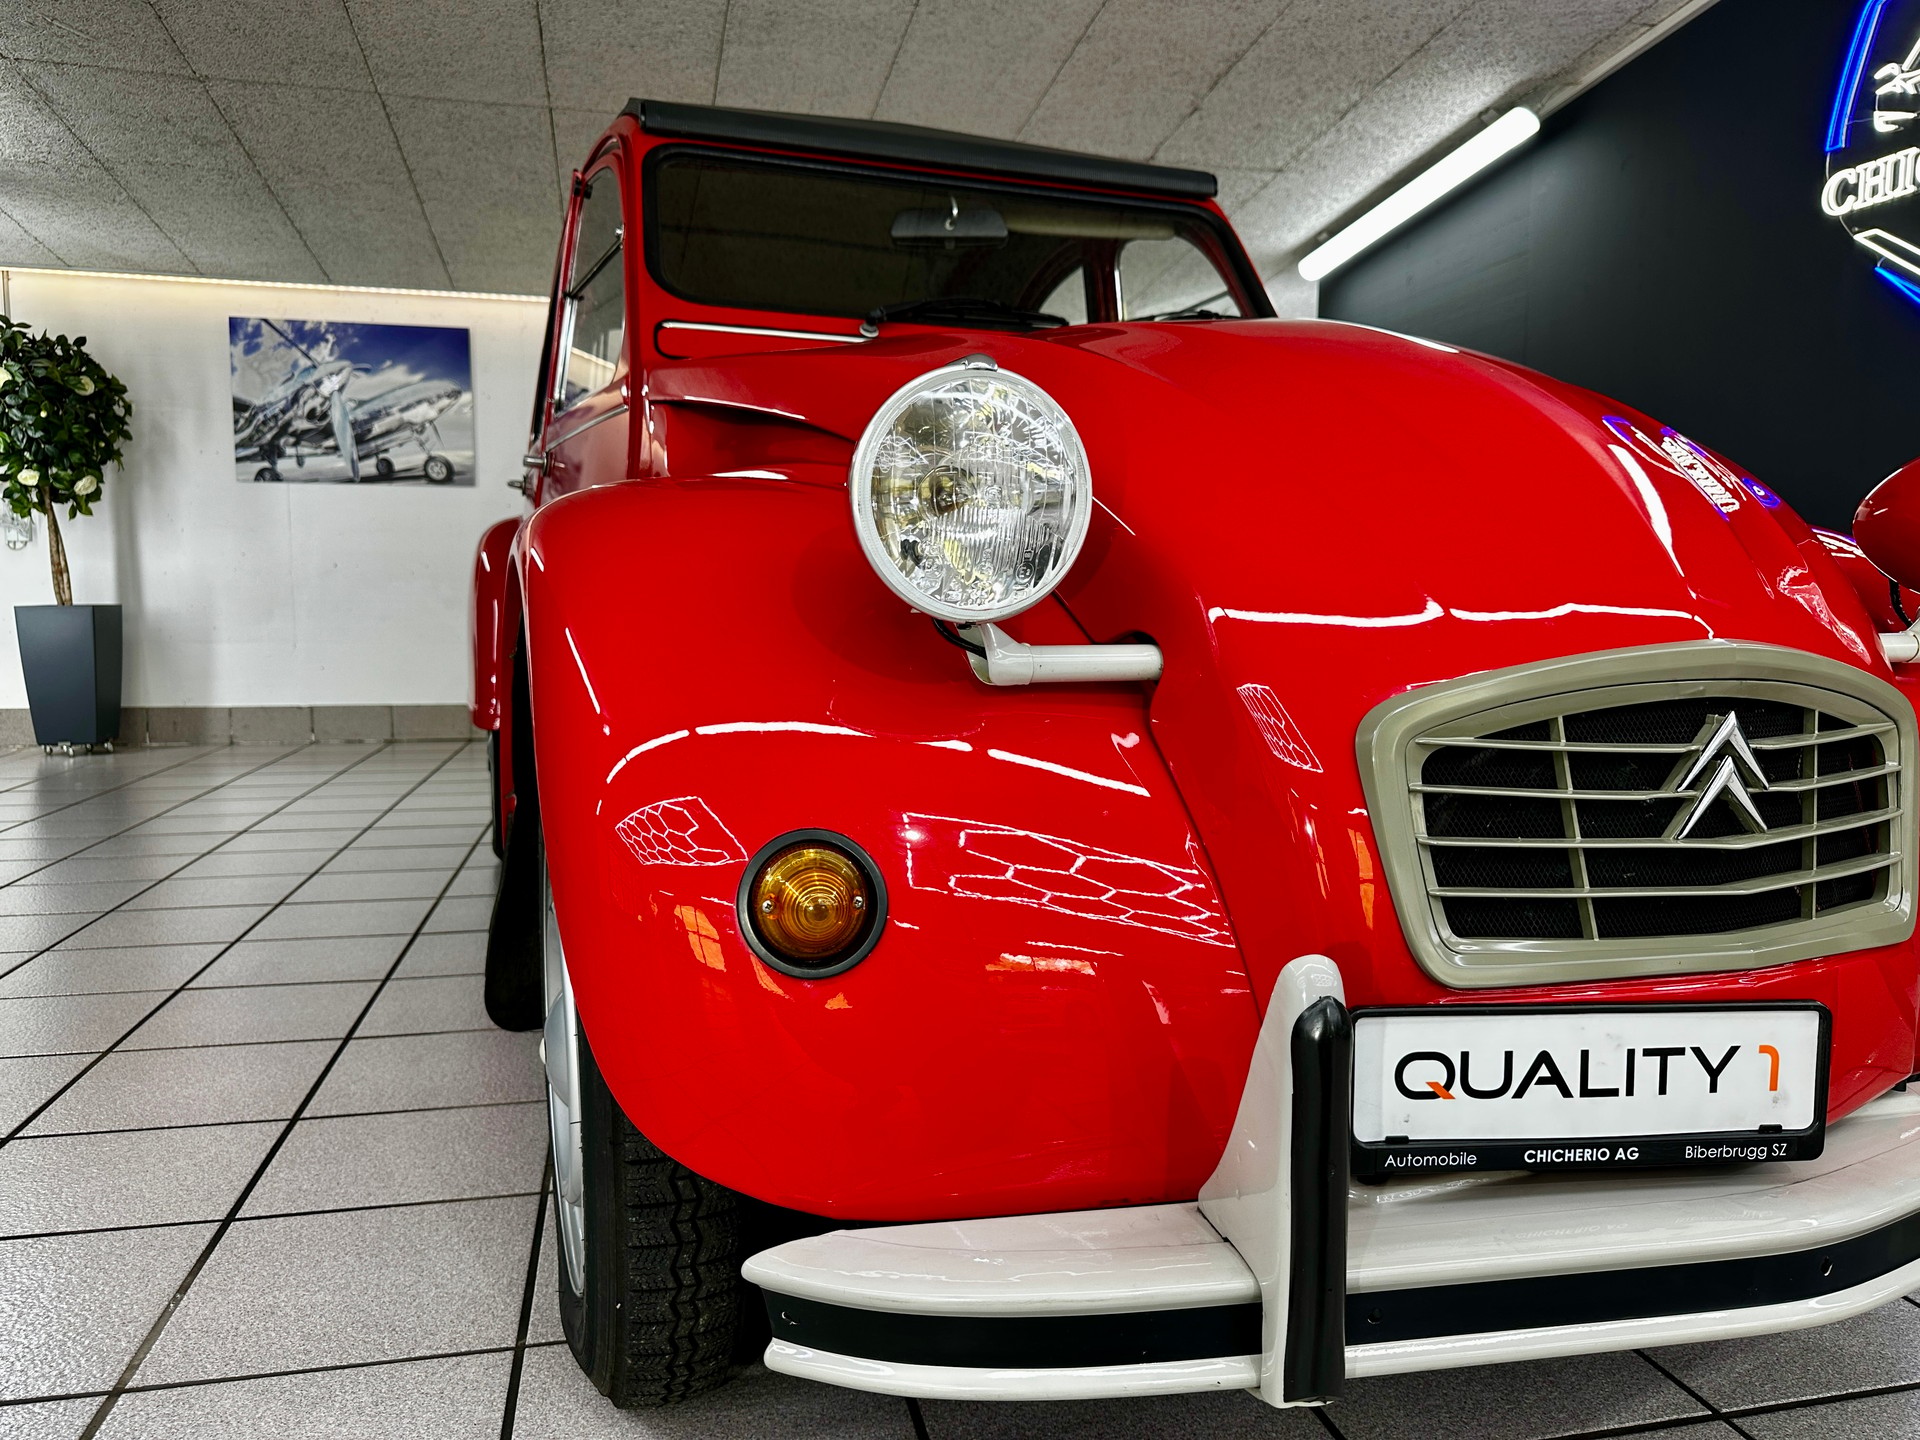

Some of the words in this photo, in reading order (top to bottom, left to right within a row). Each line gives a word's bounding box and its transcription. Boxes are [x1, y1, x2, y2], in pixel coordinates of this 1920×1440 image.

[1821, 147, 1920, 216] CHI
[1394, 1045, 1742, 1100] QUALITY
[1758, 1044, 1780, 1092] 1
[1384, 1152, 1478, 1168] Automobile
[1523, 1148, 1610, 1163] CHICHERIO
[1614, 1146, 1640, 1161] AG
[1685, 1145, 1768, 1160] Biberbrugg
[1771, 1143, 1788, 1157] SZ
